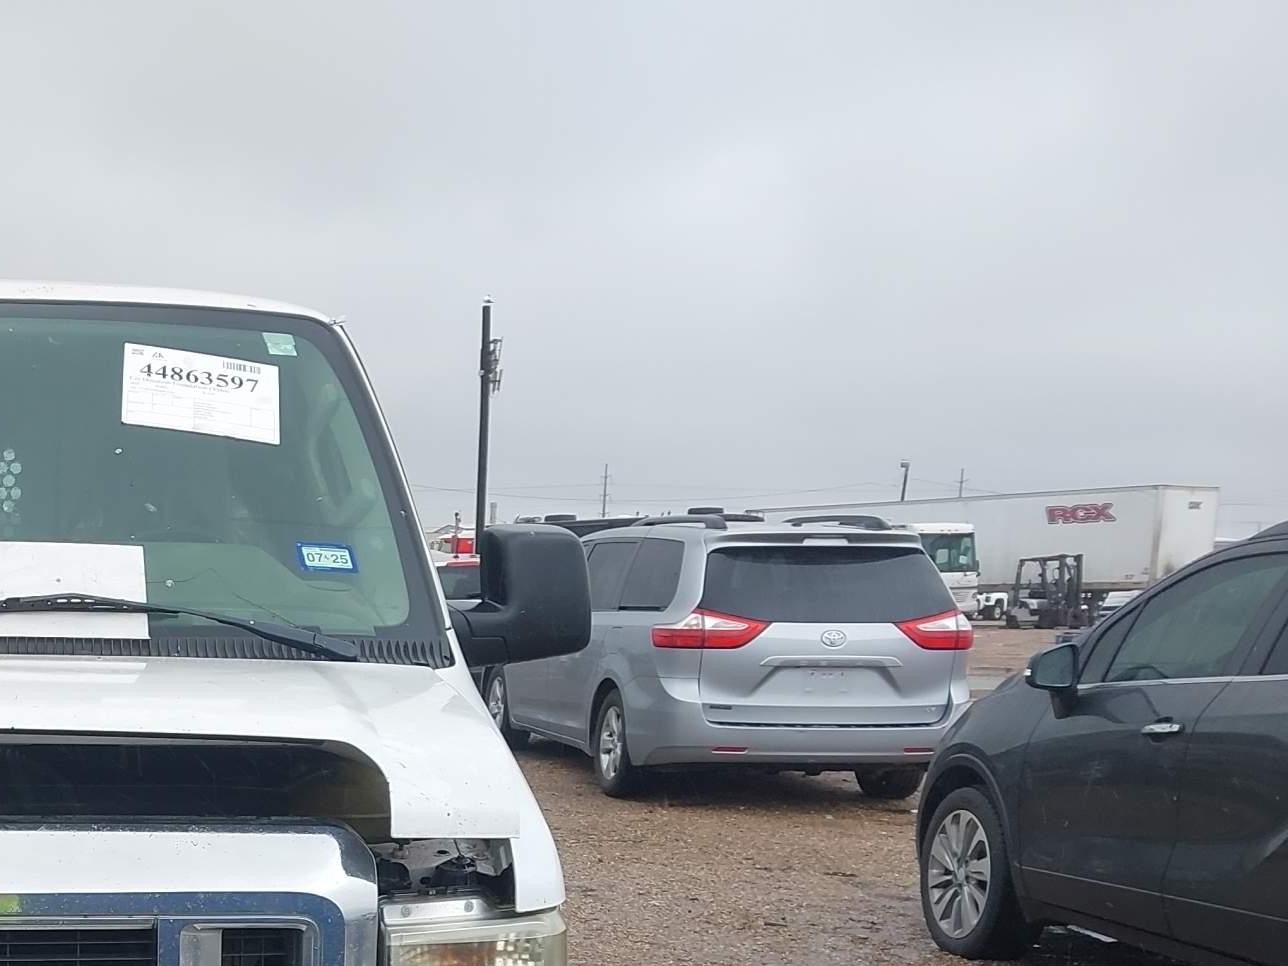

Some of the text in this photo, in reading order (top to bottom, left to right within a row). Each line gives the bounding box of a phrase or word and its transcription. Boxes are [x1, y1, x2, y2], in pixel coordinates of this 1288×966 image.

[139, 363, 259, 393] 44863597
[306, 552, 349, 565] 07 25
